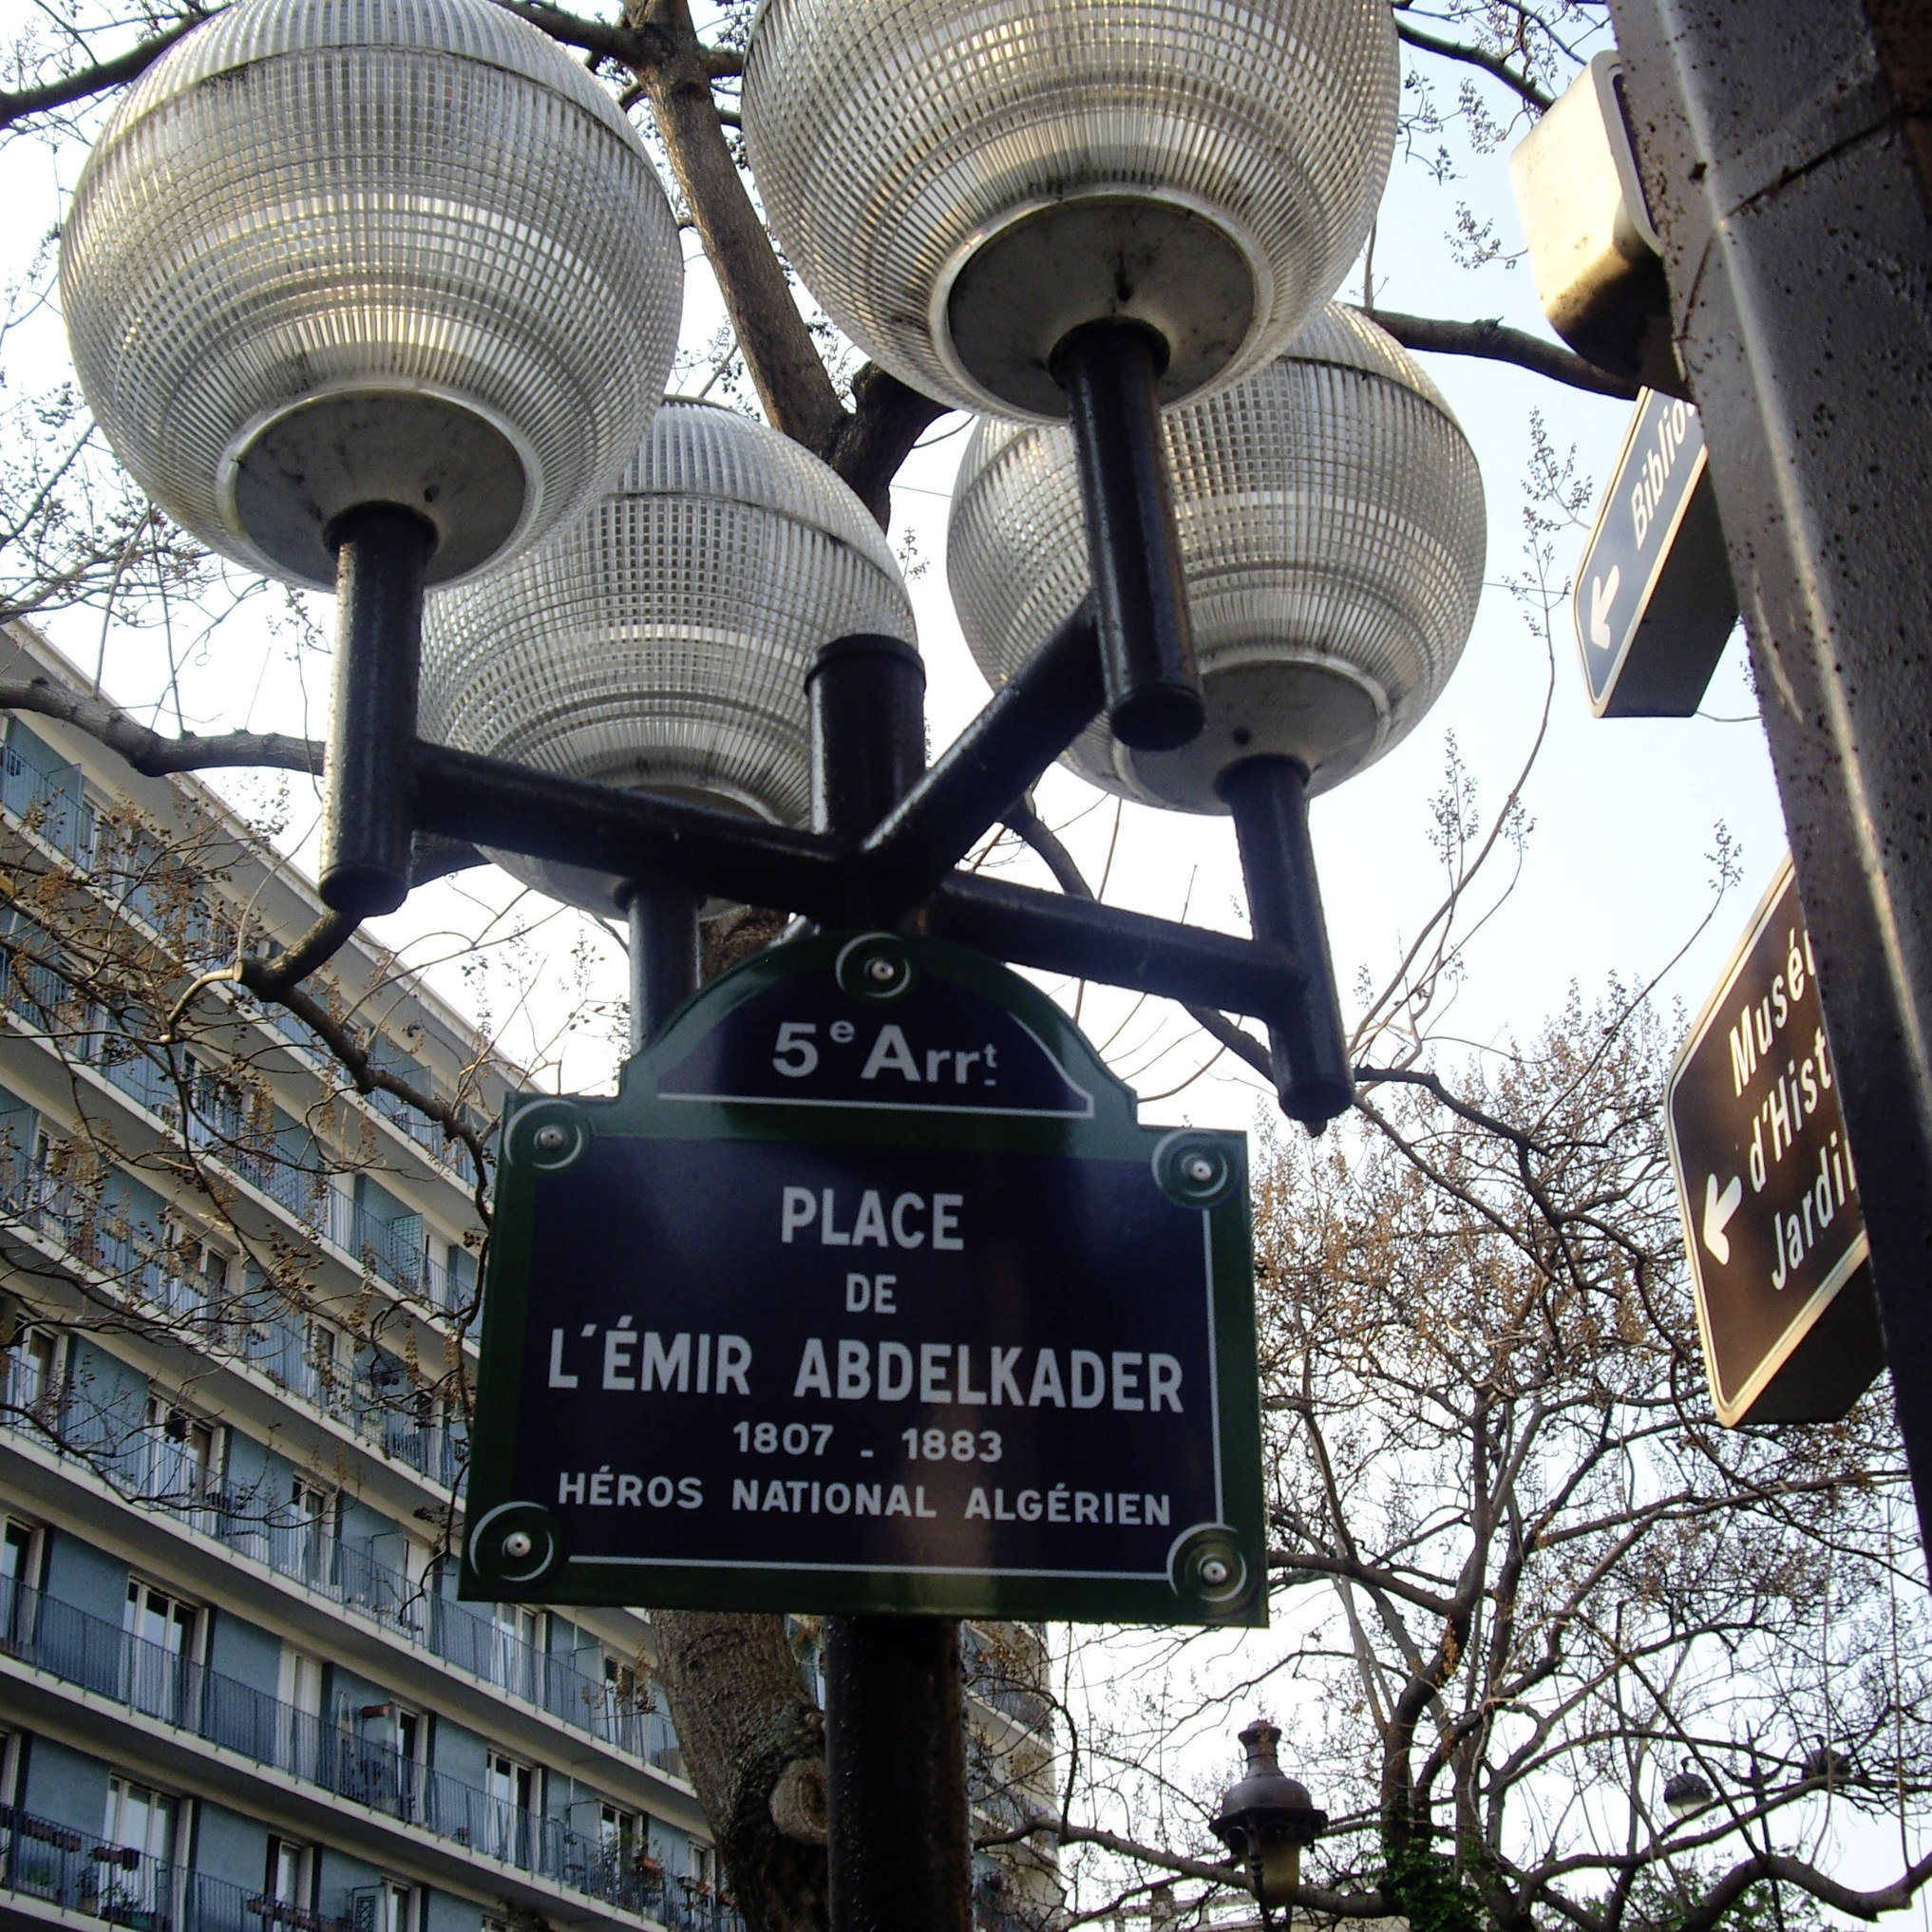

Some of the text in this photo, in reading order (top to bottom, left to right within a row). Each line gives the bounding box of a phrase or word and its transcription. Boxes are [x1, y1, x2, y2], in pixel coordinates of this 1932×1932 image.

[782, 1185, 964, 1250] PLACE
[845, 1273, 898, 1314] DE
[548, 1316, 1184, 1413] L'ÉMIR ABDELKADER
[733, 1421, 833, 1456] 1807
[901, 1428, 1003, 1464] 1883
[559, 1467, 1171, 1526] HÉROS NATIONAL ALGÉRIEN
